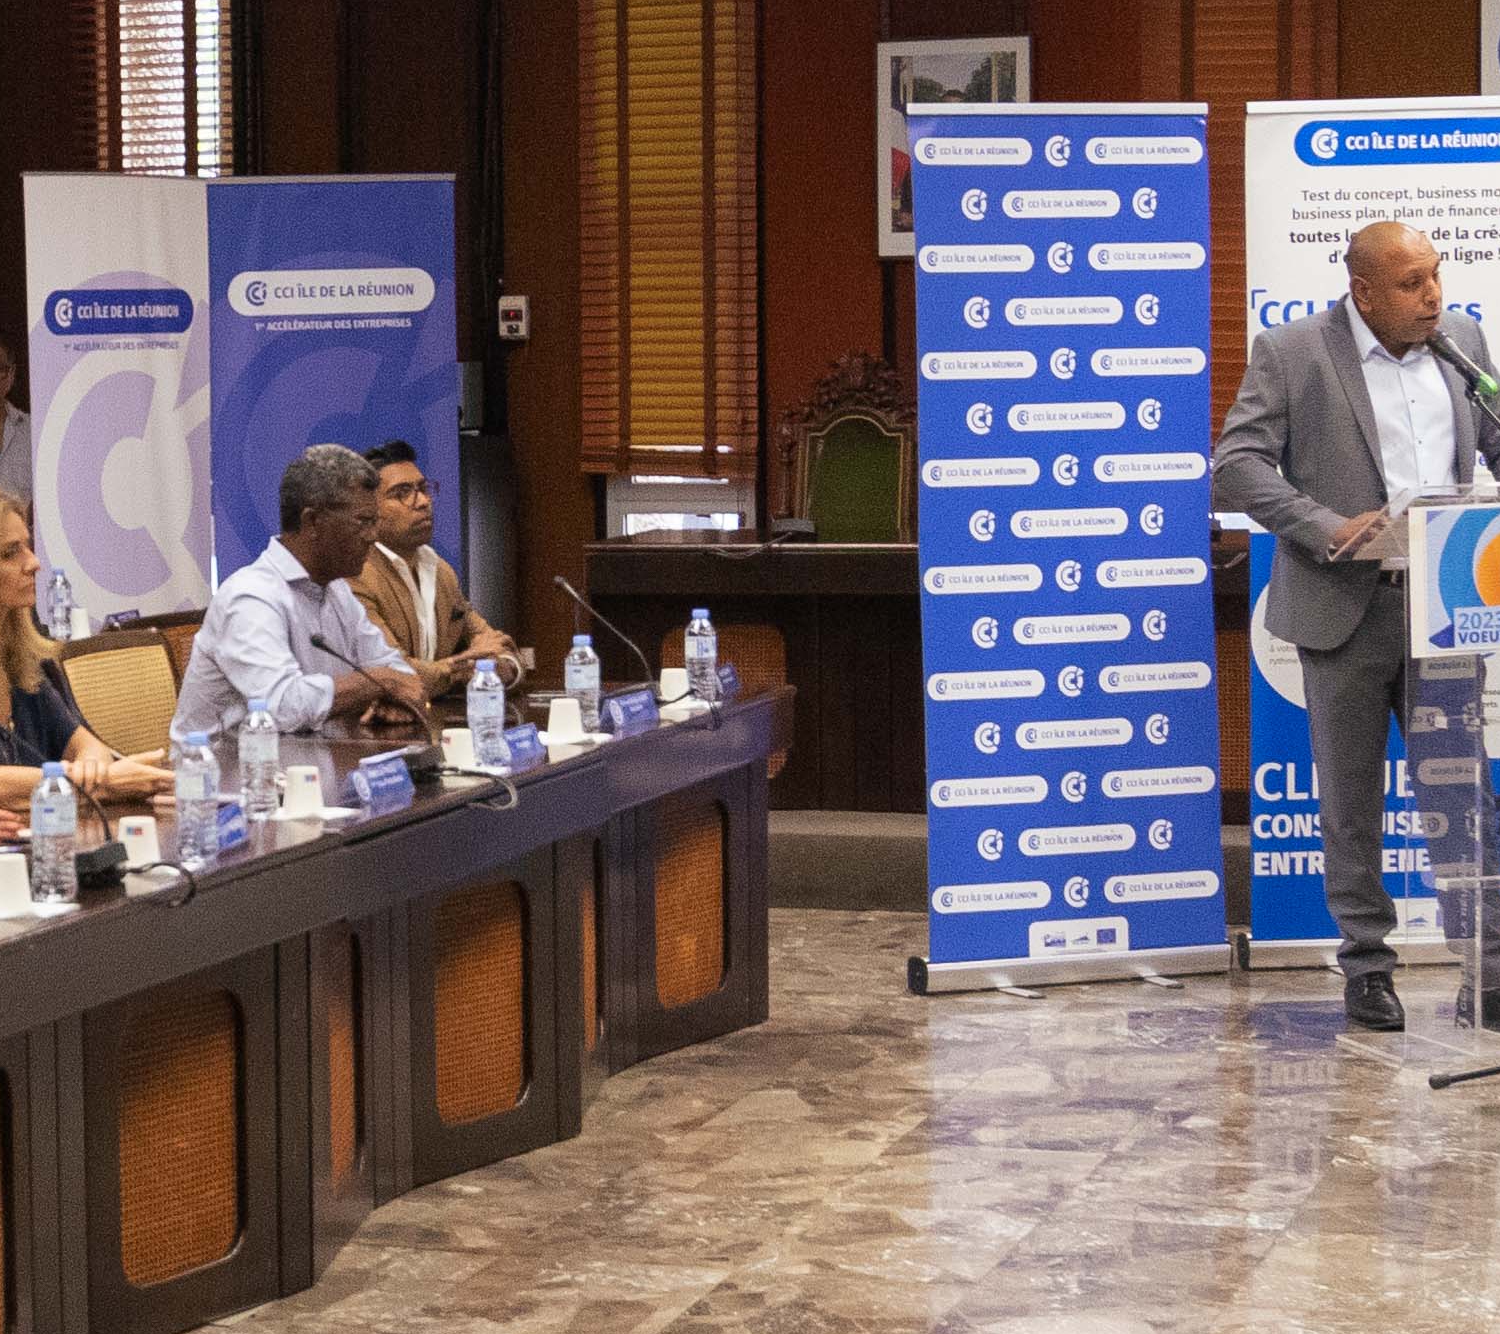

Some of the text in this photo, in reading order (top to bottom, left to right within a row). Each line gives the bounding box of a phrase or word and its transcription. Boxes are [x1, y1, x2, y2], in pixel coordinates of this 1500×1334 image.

[1345, 136, 1369, 150] CCI
[1372, 132, 1395, 149] ÎLE
[1397, 134, 1417, 149] DE
[1420, 134, 1440, 148] LA
[1301, 190, 1330, 201] Test
[1334, 189, 1350, 201] du
[1354, 189, 1412, 202] concept,
[1417, 187, 1477, 199] business
[1292, 207, 1352, 220] business
[1356, 207, 1389, 221] plan,
[1393, 206, 1423, 221] plan
[1427, 206, 1444, 217] de
[1289, 231, 1341, 243] toutes
[1431, 227, 1451, 240] de
[1455, 227, 1469, 240] la
[1454, 247, 1493, 264] ligne
[274, 282, 414, 299] CCI ÎLE DE LA RÉUNION
